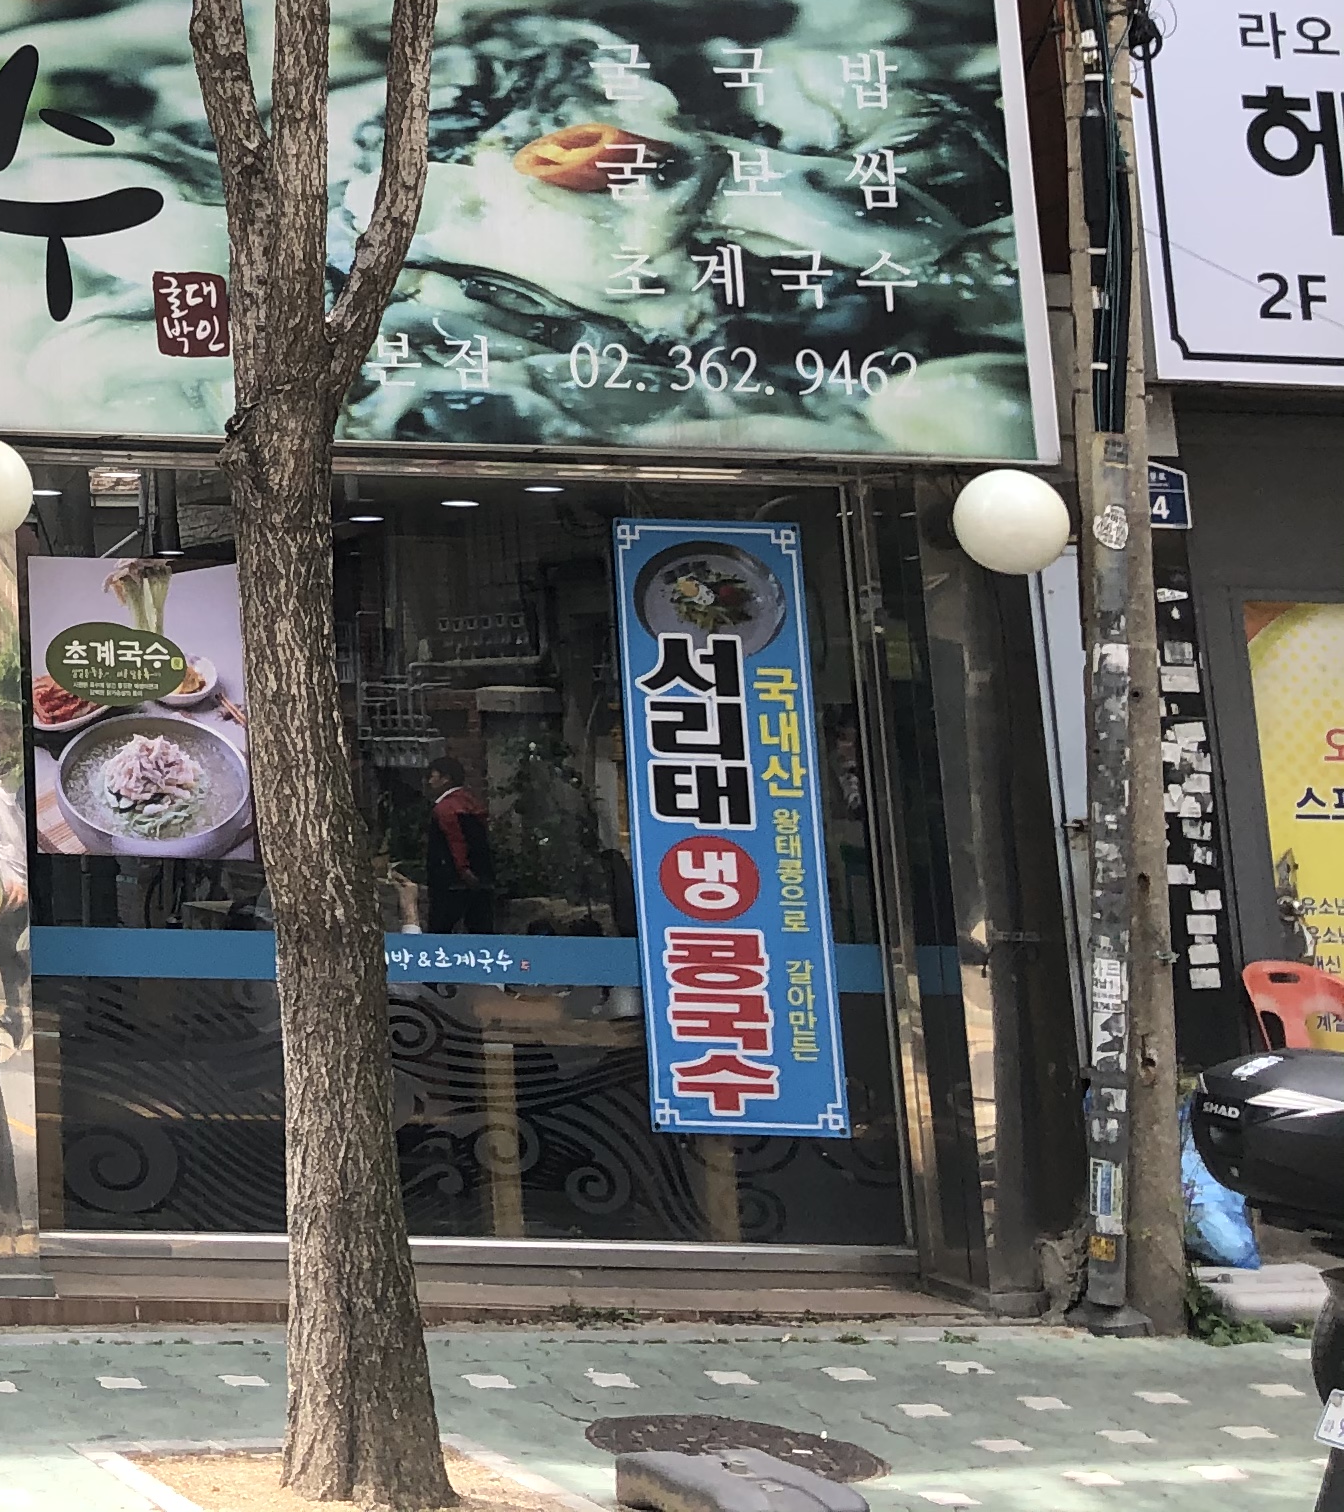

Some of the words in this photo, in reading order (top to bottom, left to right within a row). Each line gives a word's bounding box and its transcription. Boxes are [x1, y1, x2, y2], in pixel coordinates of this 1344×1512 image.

[1238, 12, 1340, 59] 라오
[1257, 272, 1327, 321] 2F
[795, 348, 921, 397] 9462
[636, 632, 757, 829] 서리태
[753, 666, 805, 798] 국내산
[677, 848, 739, 910] 냉
[434, 947, 514, 973] 초계국수
[662, 926, 779, 1116] 콩국수
[786, 959, 820, 1061] 갈아만든
[1202, 1101, 1240, 1119] SHAD
